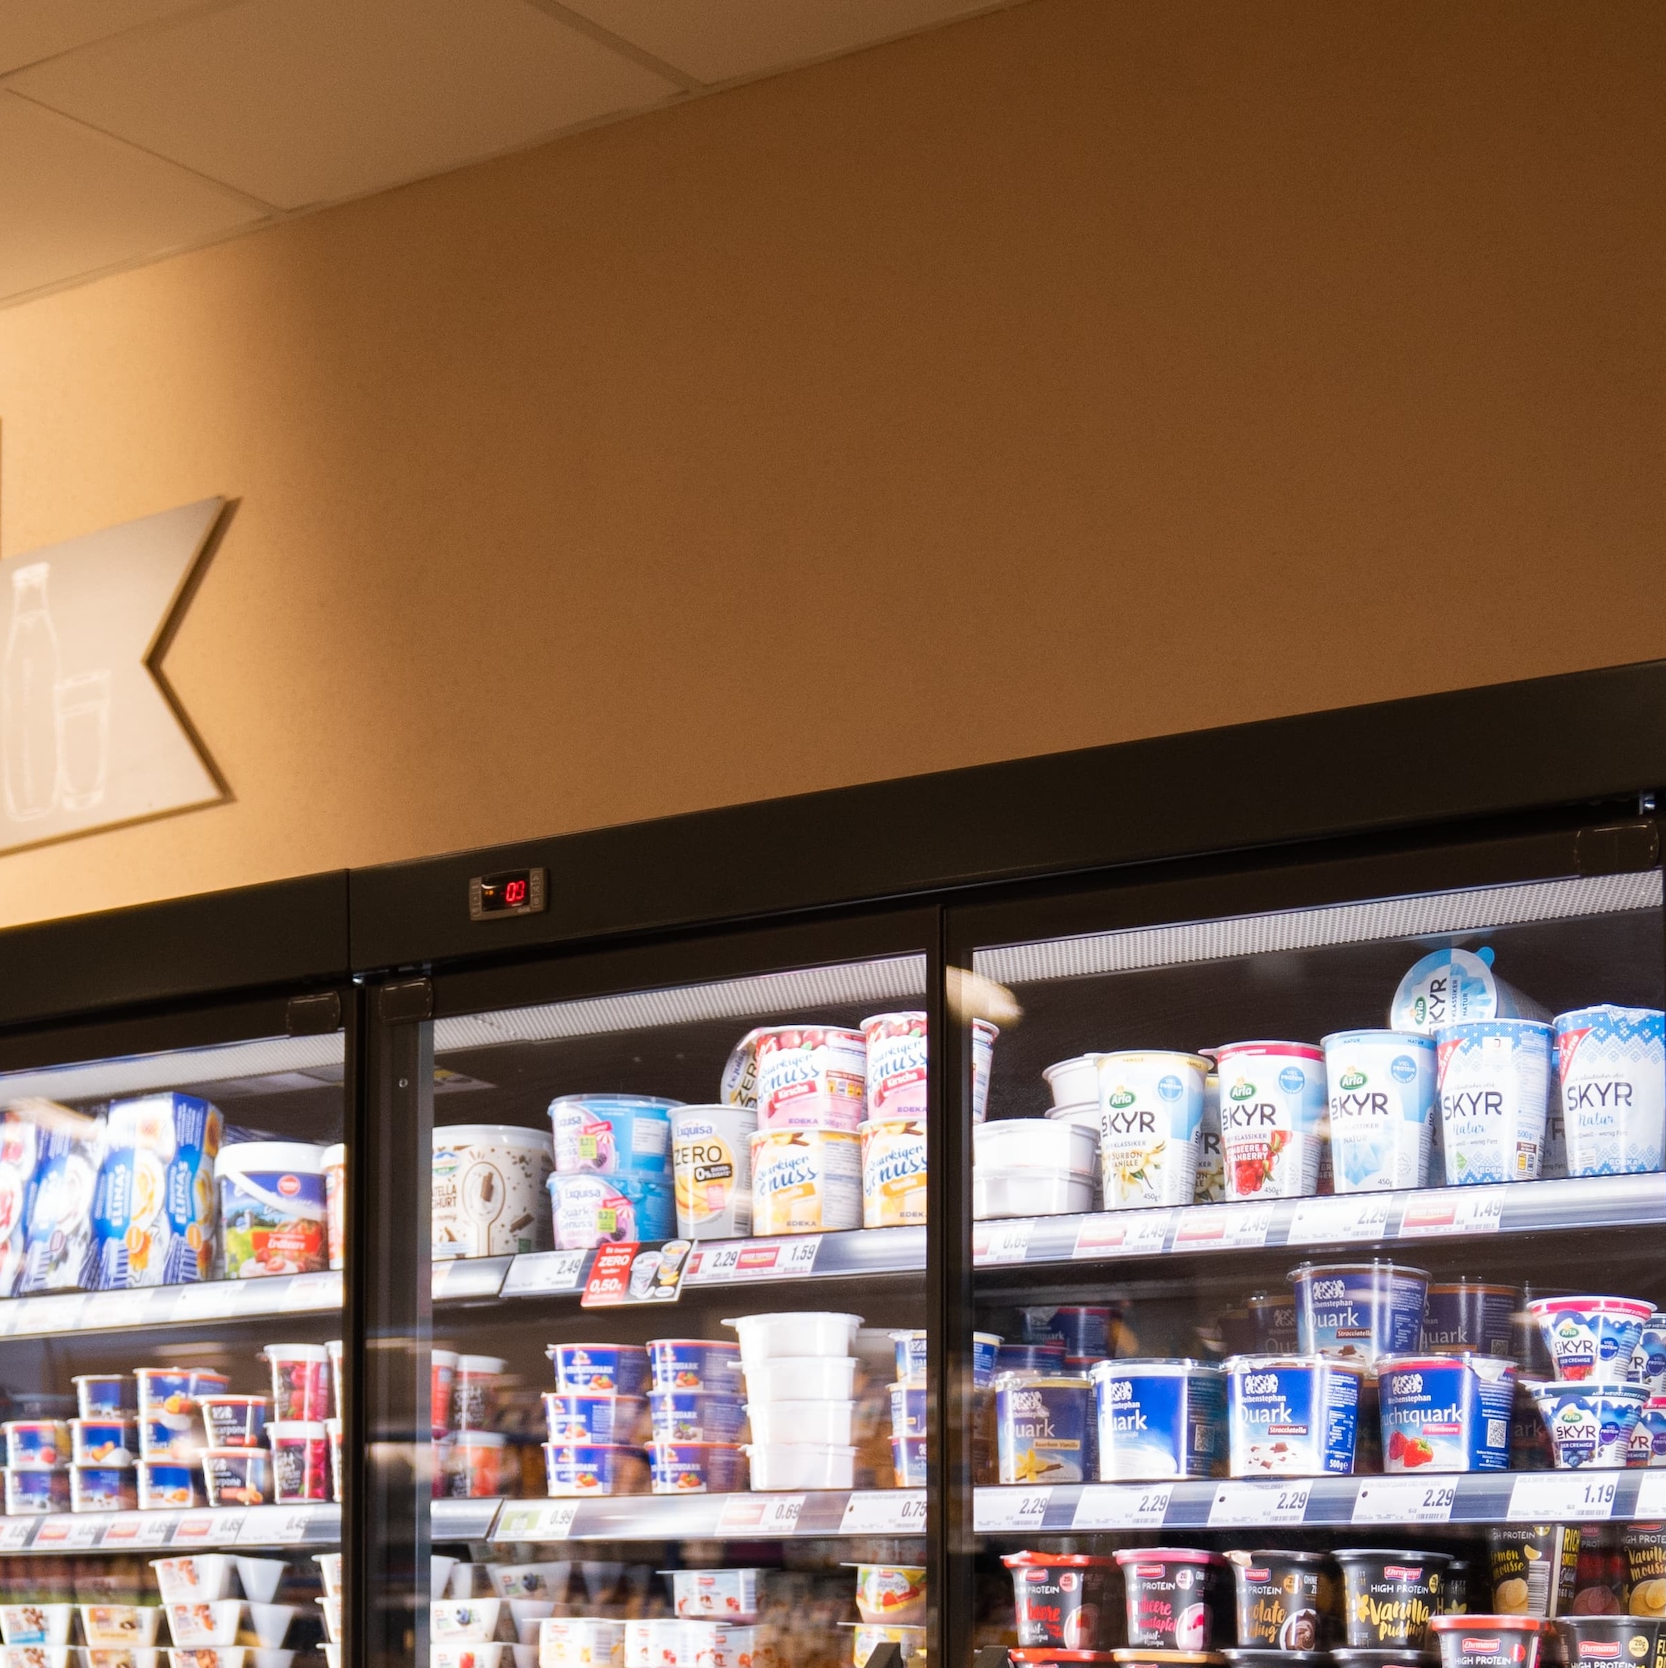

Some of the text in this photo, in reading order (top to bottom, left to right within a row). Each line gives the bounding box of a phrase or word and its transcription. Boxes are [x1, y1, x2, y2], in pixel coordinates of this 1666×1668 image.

[778, 1084, 809, 1098] Kirsche
[1110, 1093, 1132, 1106] Arla
[1567, 1082, 1633, 1111] SKYR
[1444, 1092, 1503, 1120] SKYR
[1101, 1111, 1155, 1137] SKYR
[674, 1146, 722, 1165] ZERO
[175, 1160, 189, 1225] ELINAS
[1472, 1200, 1501, 1217] 1.49
[791, 1245, 815, 1260] 1.59
[1305, 1311, 1359, 1329] Quark
[1269, 1426, 1307, 1435] Stracciatella
[1277, 1492, 1307, 1510] 2.29
[1423, 1488, 1453, 1507] 2.29
[1584, 1484, 1614, 1504] 1.19
[1019, 1498, 1048, 1515] 2.29
[1138, 1495, 1168, 1512] 2.29
[1369, 1597, 1429, 1625] Vanilla
[1463, 1640, 1500, 1651] Ehrmann
